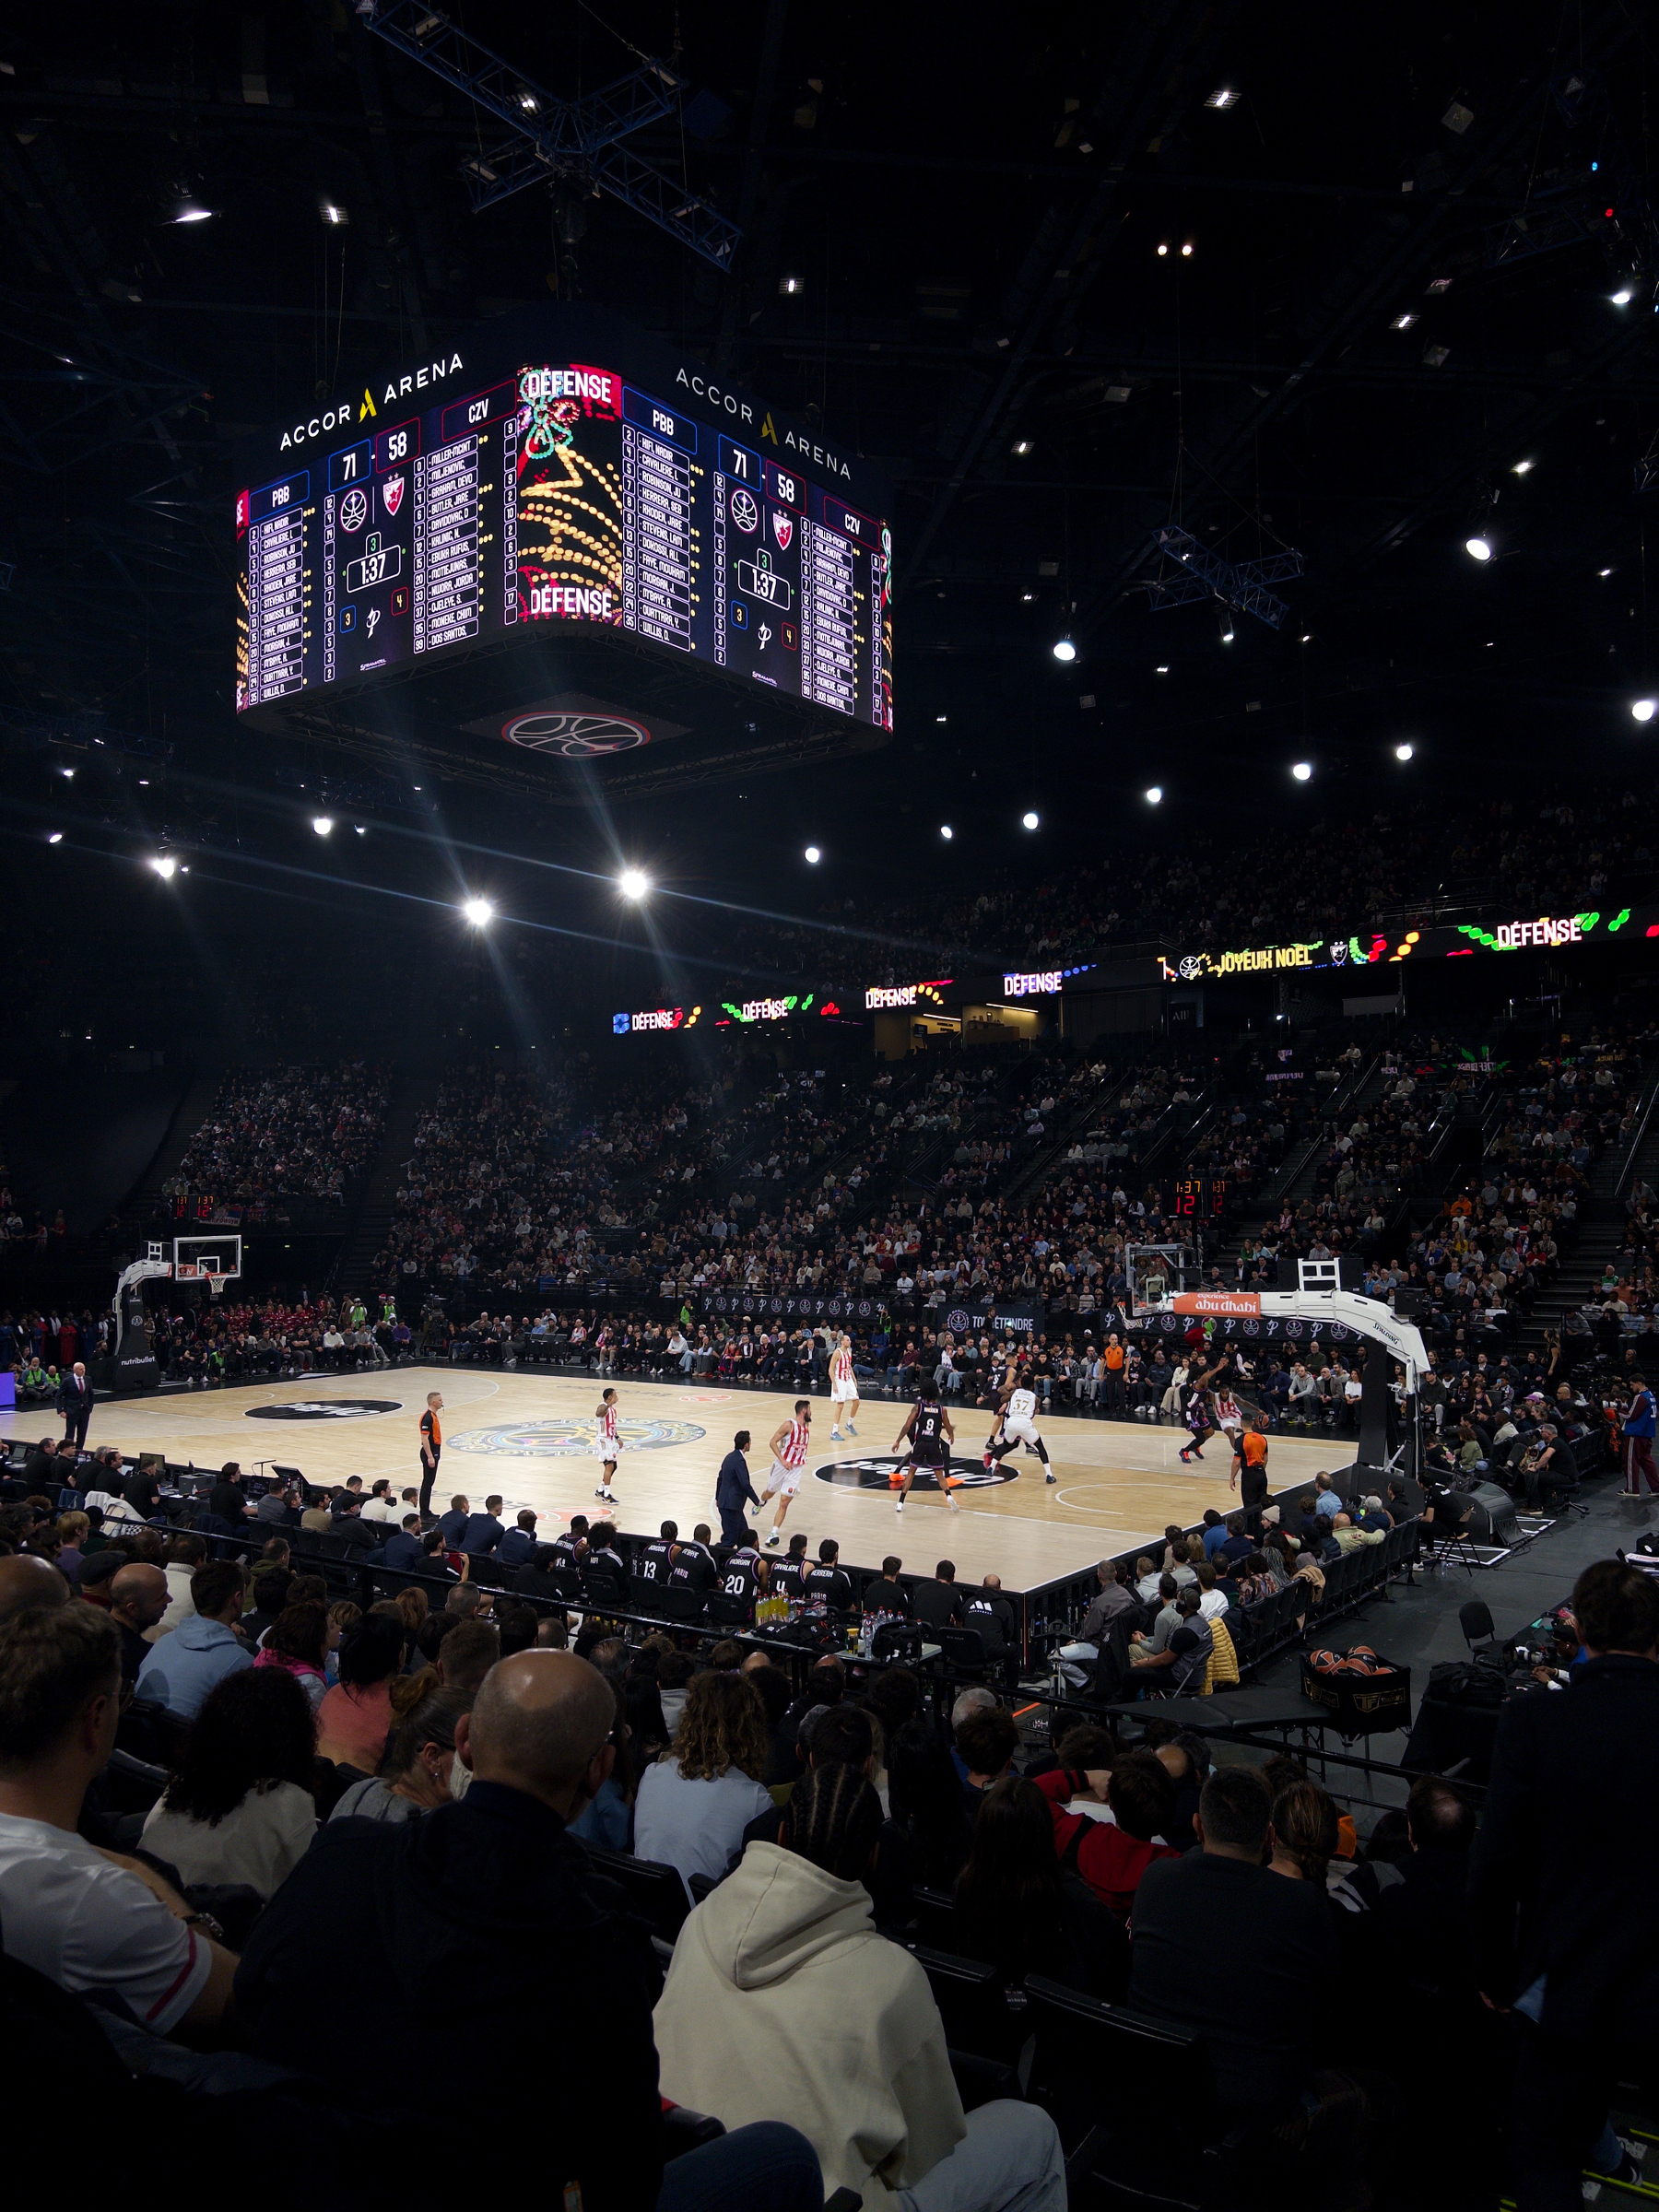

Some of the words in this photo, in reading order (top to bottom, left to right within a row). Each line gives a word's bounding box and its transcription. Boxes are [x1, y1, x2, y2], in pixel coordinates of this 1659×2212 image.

[528, 370, 612, 404] DÉFENSE
[280, 405, 351, 451] ACCOR
[383, 354, 463, 404] ARENA
[468, 398, 488, 424] CZV
[508, 423, 512, 433] 9
[653, 409, 674, 435] PBB
[677, 368, 752, 424] ACCOR
[785, 431, 851, 480] ARENA
[626, 429, 630, 441] 2
[343, 453, 356, 481] 71
[389, 431, 407, 461] 58
[626, 446, 630, 457] 4
[417, 461, 421, 471] 0
[626, 464, 631, 474] 5
[508, 474, 512, 485] 9
[734, 448, 747, 478] 71
[778, 474, 794, 502] 58
[417, 477, 421, 487] 2
[627, 480, 630, 489] 7
[716, 476, 722, 487] 12
[273, 485, 289, 507] PBB
[417, 493, 421, 503] 4
[508, 490, 512, 501] 2
[717, 491, 722, 501] 4
[627, 498, 631, 507] 8
[417, 510, 421, 520] 6
[506, 507, 513, 519] 10
[716, 507, 723, 518] 14
[627, 514, 631, 524] 9
[844, 514, 861, 535] CZV
[417, 525, 421, 535] 7
[508, 524, 512, 535] 2
[626, 531, 632, 541] 13
[371, 538, 376, 551] 3
[416, 541, 422, 552] 12
[508, 543, 512, 552] 6
[717, 539, 722, 549] 5
[626, 547, 632, 558] 15
[416, 558, 422, 569] 15
[508, 559, 512, 570] 3
[717, 555, 722, 565] 8
[761, 555, 768, 568] 3
[361, 553, 385, 584] 1:37
[625, 564, 633, 575] 20
[416, 573, 423, 585] 20
[717, 571, 722, 581] 7
[626, 581, 633, 593] 22
[752, 569, 776, 599] 1:37
[416, 590, 423, 601] 33
[717, 586, 722, 596] 8
[396, 595, 402, 607] 4
[507, 592, 513, 604] 17
[531, 584, 612, 618] DÉFENSE
[626, 597, 633, 609] 24
[416, 606, 422, 618] 37
[717, 603, 722, 613] 3
[346, 613, 350, 625] 3
[626, 614, 633, 627] 35
[737, 608, 742, 621] 3
[416, 622, 423, 634] 95
[718, 618, 722, 629] 5
[717, 635, 722, 645] 3
[787, 629, 792, 642] 4
[416, 639, 423, 650] 99
[718, 651, 722, 662] 2
[1498, 916, 1582, 949] DÉFENSE
[1218, 949, 1272, 973] JOYEUX
[1276, 944, 1312, 968] NOËL
[1005, 971, 1062, 995] DÉFENSE
[865, 985, 916, 1009] DÉFENSE
[743, 995, 788, 1019] DÉFENSE
[632, 1008, 673, 1030] DÉFENSE
[1176, 1181, 1200, 1193] 1:37
[1213, 1181, 1225, 1193] 1:37
[1176, 1195, 1194, 1214] 12
[177, 1206, 184, 1217] 12
[197, 1206, 209, 1217] 12
[1195, 1300, 1218, 1311] abu
[1220, 1300, 1257, 1312] dhabi
[1373, 1322, 1399, 1345] SPALDING
[1015, 1400, 1029, 1410] 37
[927, 1418, 934, 1430] 8
[729, 1558, 751, 1566] MORGAN
[644, 1561, 656, 1579] 13
[673, 1567, 688, 1579] PARIS
[811, 1570, 833, 1578] HERRERA
[725, 1574, 745, 1594] 20
[776, 1581, 785, 1593] 4
[811, 1592, 827, 1601] PARIS
